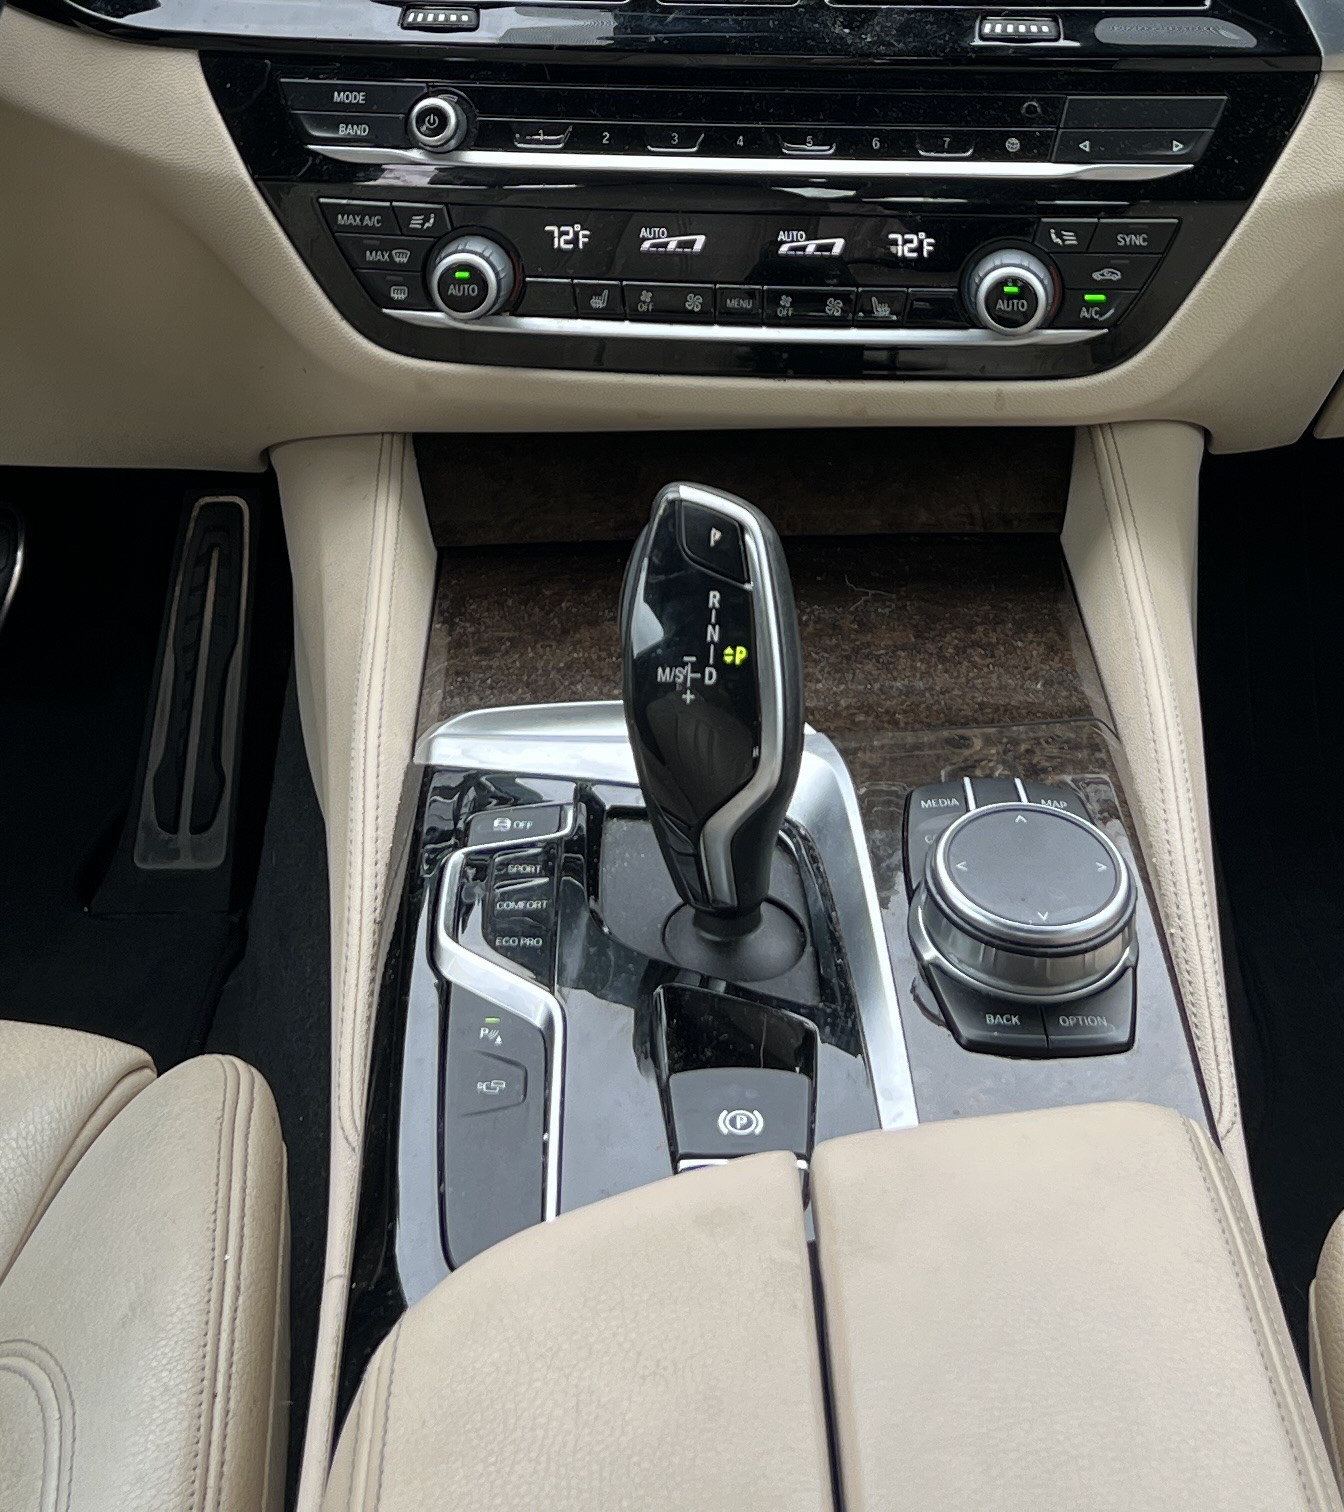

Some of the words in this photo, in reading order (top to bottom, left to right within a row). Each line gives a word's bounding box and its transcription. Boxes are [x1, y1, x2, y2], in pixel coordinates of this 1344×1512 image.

[333, 91, 366, 104] MODE
[338, 123, 369, 136] BAND
[602, 132, 610, 144] 2
[670, 133, 679, 145] 3
[736, 135, 744, 147] 4
[805, 136, 813, 147] 5
[872, 137, 880, 149] 6
[942, 137, 951, 149] 7
[337, 213, 360, 225] MAX
[363, 215, 382, 227] A/C
[639, 227, 668, 239] AUTO
[777, 231, 806, 242] AUTO
[1116, 234, 1148, 246] SYNC
[365, 250, 390, 262] MAX
[447, 284, 478, 296] AUTO
[637, 303, 654, 312] OFF
[726, 298, 753, 309] MENU
[995, 299, 1028, 312] AUTO
[777, 307, 794, 317] OFF
[1079, 307, 1101, 320] A/C
[709, 528, 721, 547] P
[708, 590, 720, 609] R
[706, 624, 720, 643] N
[734, 646, 748, 666] P
[704, 667, 717, 685] D
[920, 798, 960, 809] MEDIA
[1040, 798, 1068, 809] MAP
[507, 864, 542, 874] SPORT
[496, 900, 548, 910] COMFORT
[495, 937, 518, 947] ECO
[520, 937, 543, 947] PRO
[985, 1013, 1021, 1025] BACK
[1058, 1015, 1107, 1027] OPTION
